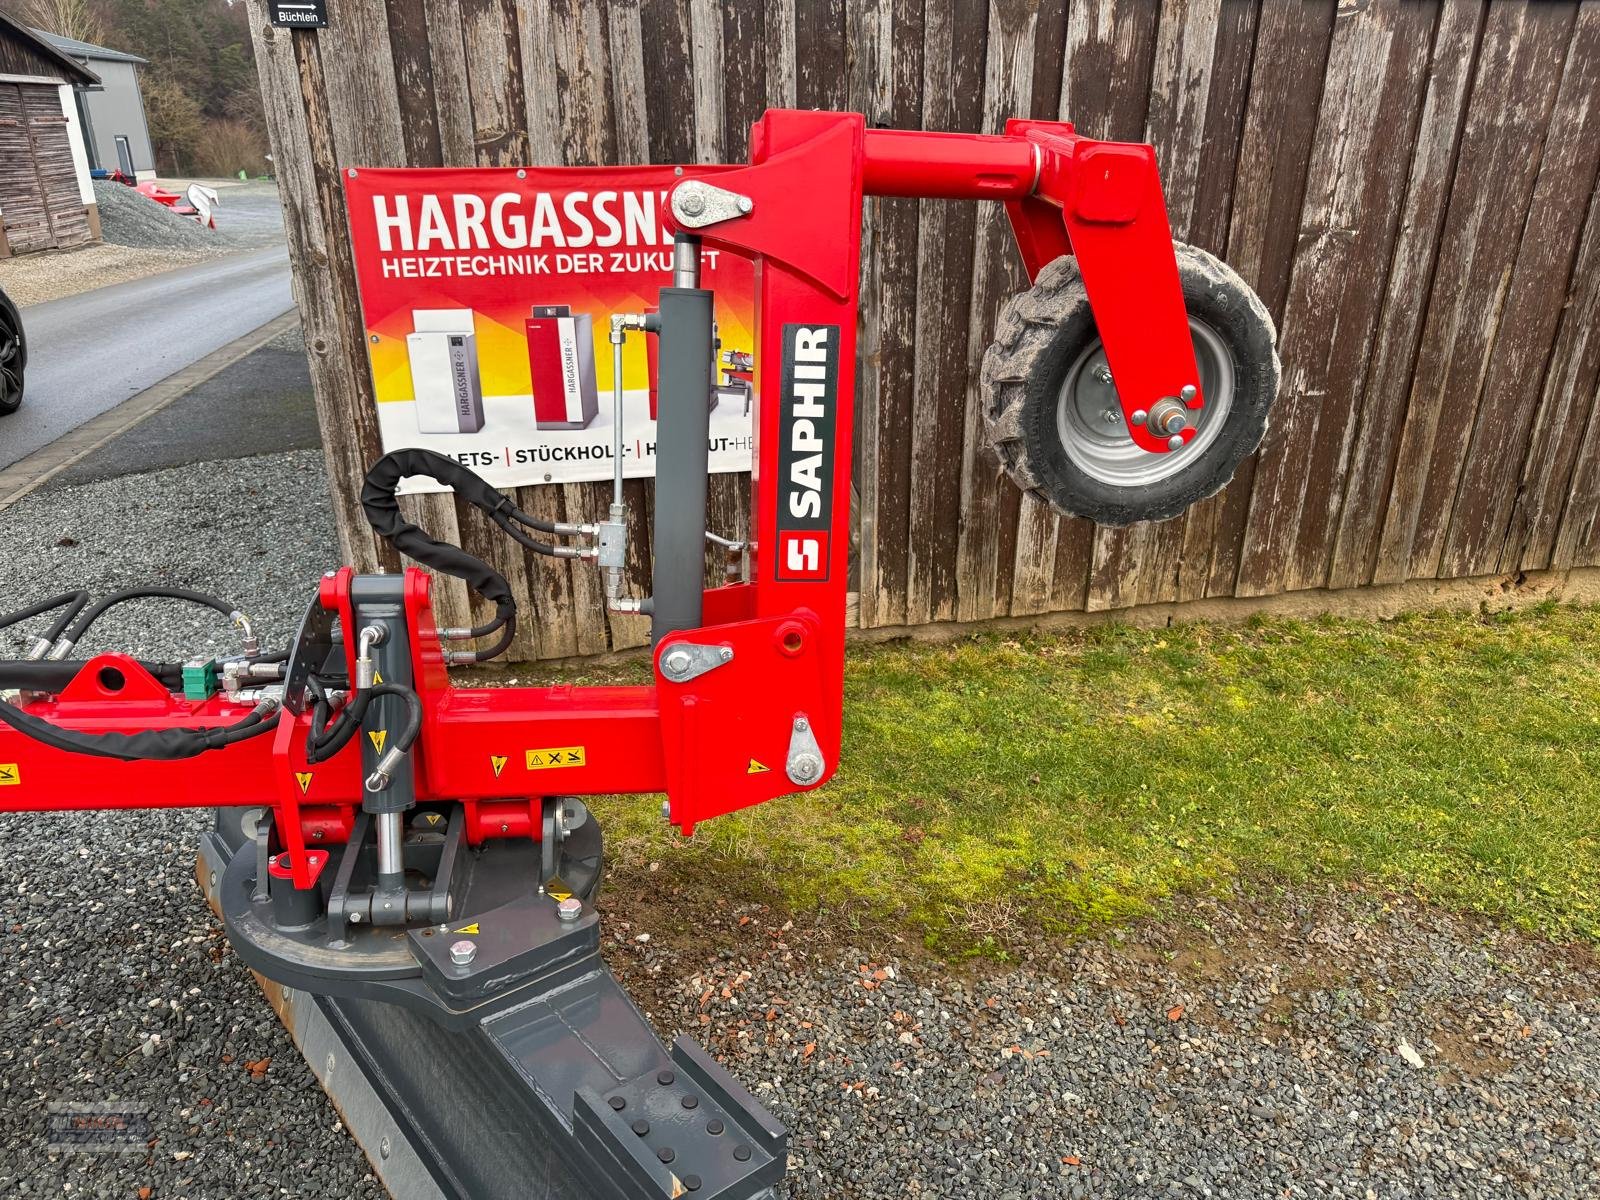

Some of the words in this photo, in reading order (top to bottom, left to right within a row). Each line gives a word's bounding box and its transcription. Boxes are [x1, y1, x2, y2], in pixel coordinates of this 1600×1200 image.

[278, 11, 319, 22] Büchlein
[372, 190, 674, 251] HARGASSN
[382, 254, 549, 278] HEIZTECHNIK
[556, 252, 604, 273] DER
[609, 250, 720, 272] ZUKUT
[455, 361, 471, 416] HARGASSNER
[564, 347, 577, 393] HARGASSNER
[789, 327, 828, 519] SAPHIR
